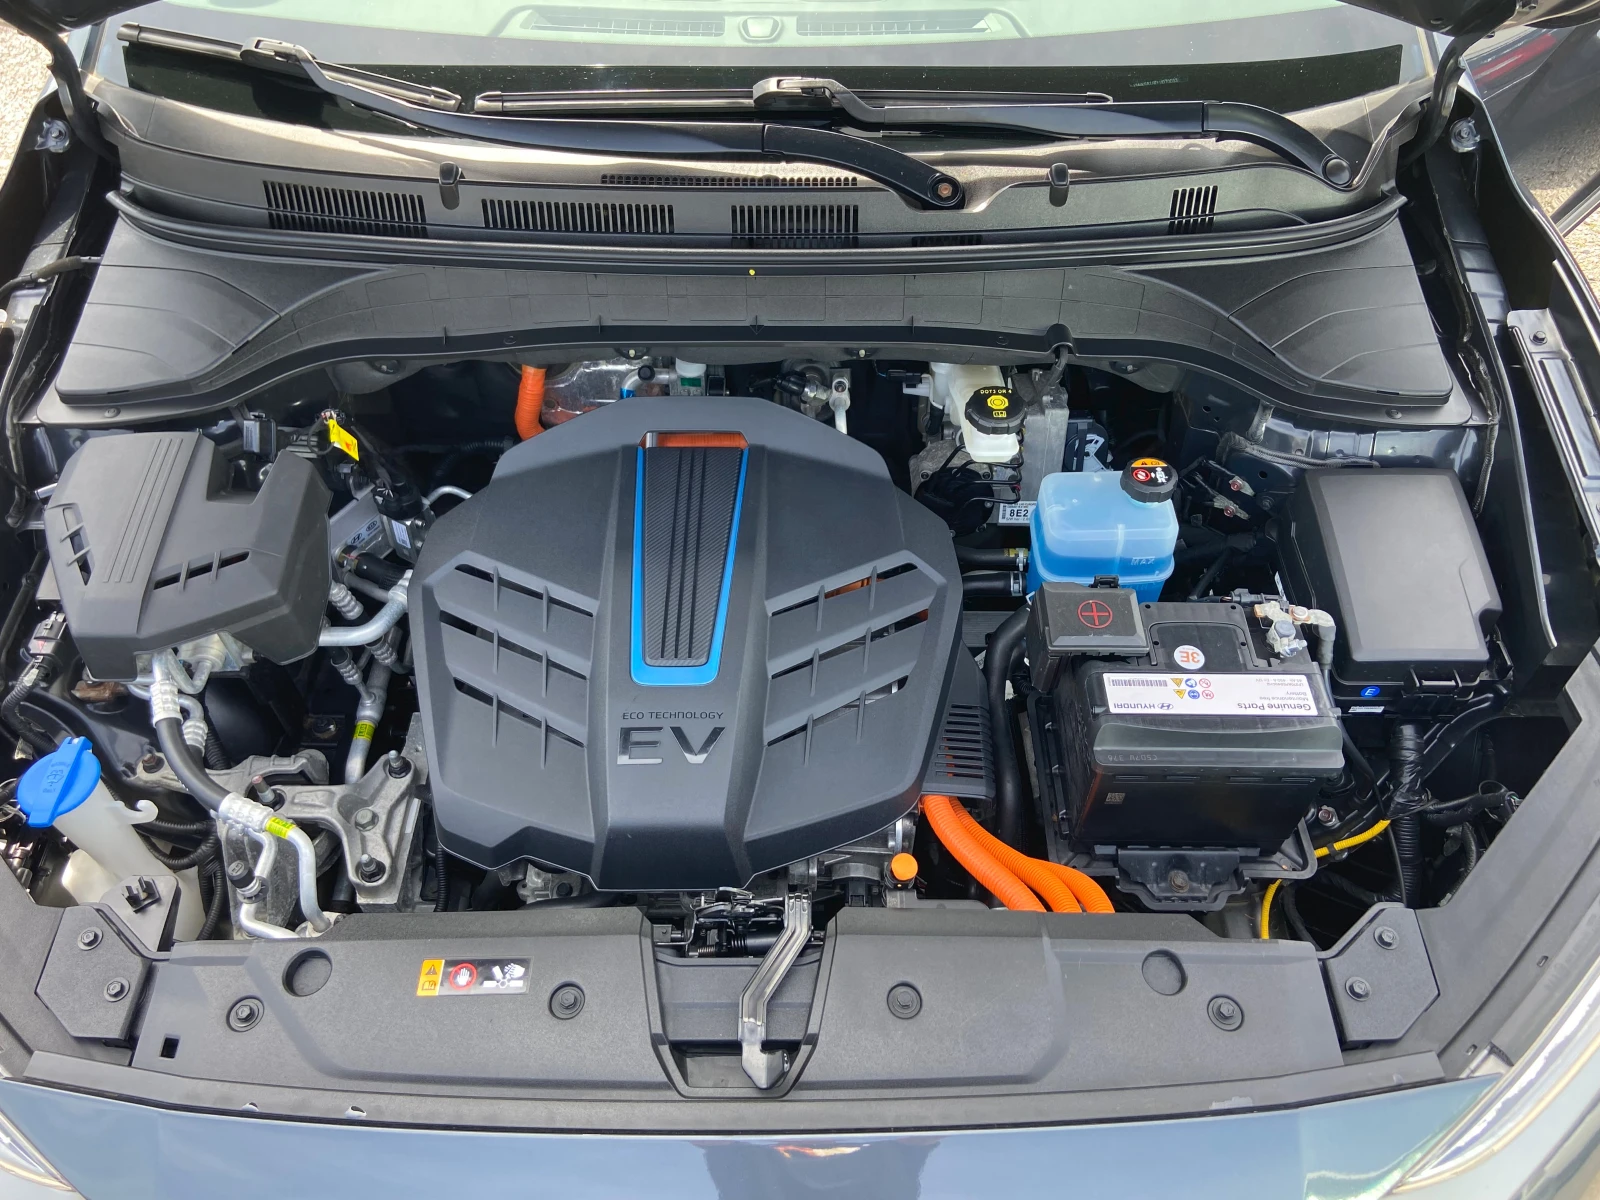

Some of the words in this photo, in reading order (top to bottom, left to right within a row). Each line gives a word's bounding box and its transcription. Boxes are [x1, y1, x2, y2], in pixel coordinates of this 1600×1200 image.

[1010, 509, 1028, 517] 8E2
[1179, 651, 1200, 663] 3E
[617, 726, 725, 765] EV
